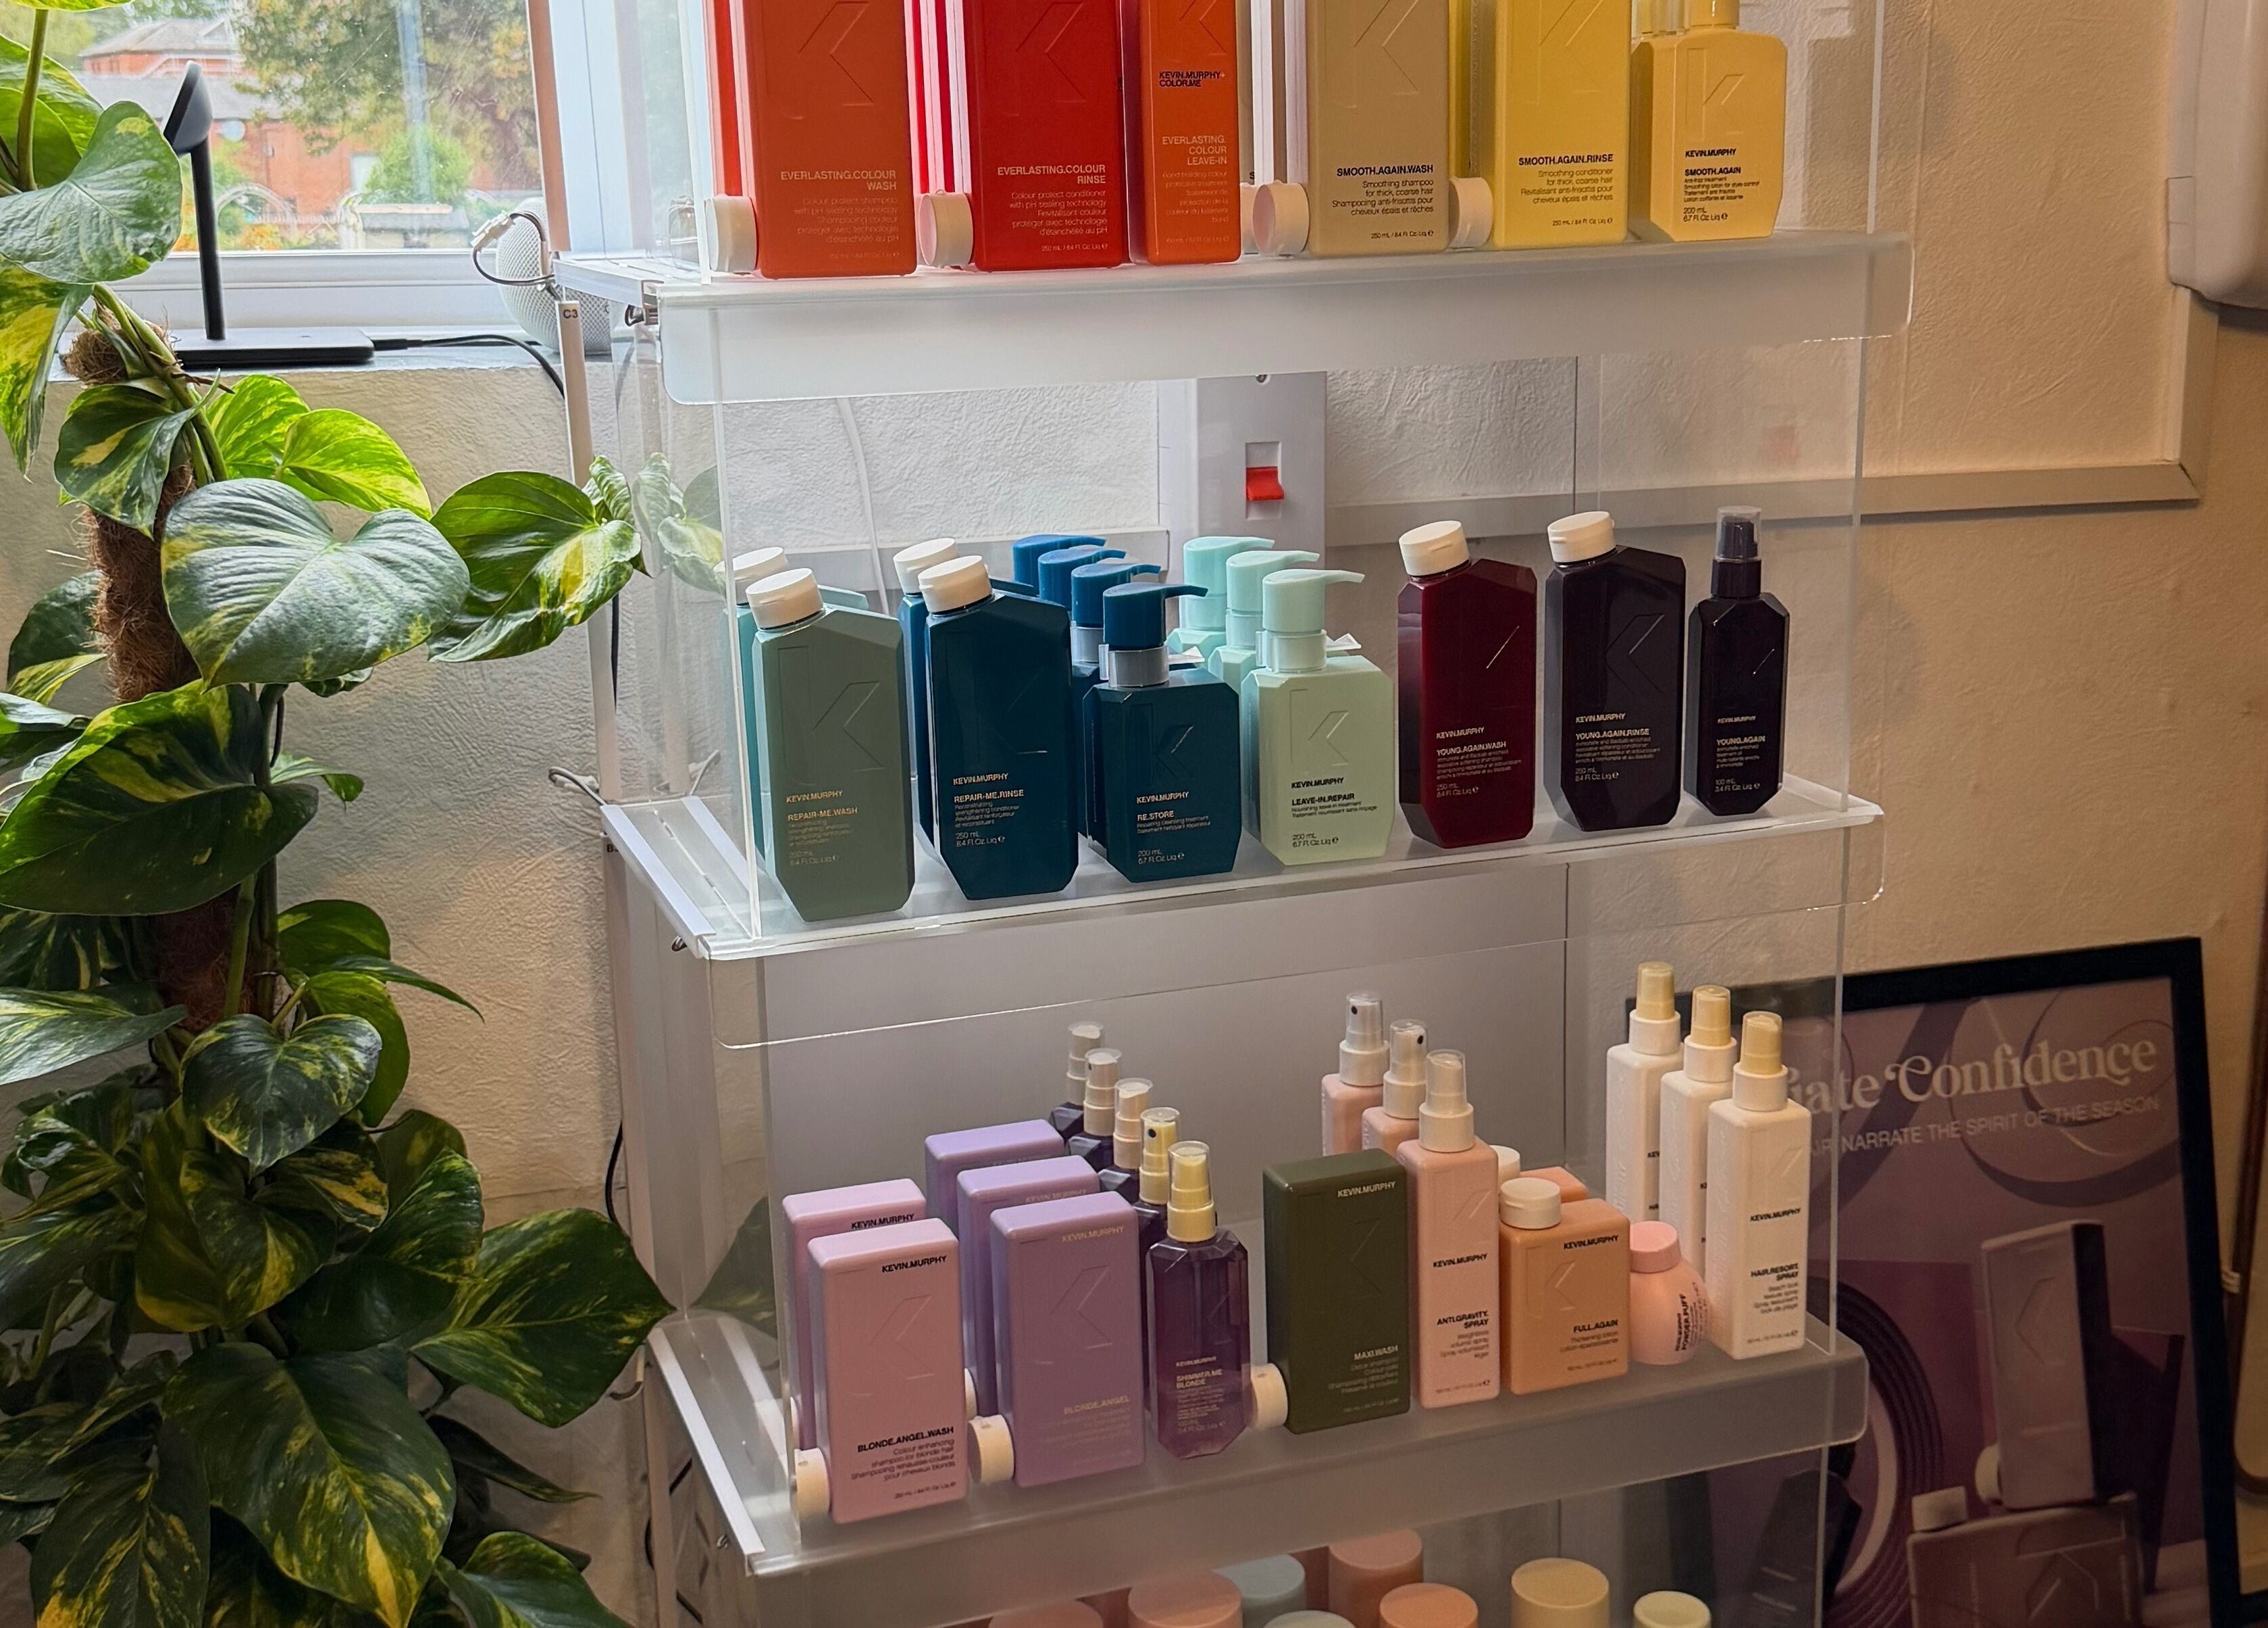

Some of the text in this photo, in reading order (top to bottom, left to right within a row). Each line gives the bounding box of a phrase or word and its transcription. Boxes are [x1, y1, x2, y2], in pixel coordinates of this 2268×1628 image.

[1159, 79, 1202, 87] COLOR.ME
[1189, 146, 1227, 155] COLOUR
[1685, 149, 1736, 157] KEVIN.MURPHY
[1187, 156, 1227, 166] LEAVE-IN
[1519, 154, 1614, 166] SMOOTH.AGAIN.RINSE
[781, 170, 896, 180] EVERLASTING.COLOUR
[998, 165, 1106, 176] EVERLASTING.COLOUR
[1337, 165, 1433, 176] SMOOTH.AGAIN.WASH
[1685, 167, 1741, 176] SMOOTH.AGAIN
[1077, 176, 1106, 184] RINSE
[867, 182, 897, 190] WASH
[1038, 191, 1064, 199] protect
[1333, 199, 1376, 207] Shampooing
[563, 309, 578, 319] C3
[1576, 713, 1626, 723] KEVIN.MURPHY
[1437, 727, 1484, 739] KEVIN.MURPHY
[1576, 729, 1649, 740] YOUNG.AGAIN.RINSE
[1717, 736, 1766, 745] YOUNG.AGAIN
[1437, 741, 1506, 756] YOUNG.AGAIN.WASH
[953, 773, 1008, 785] KEVIN.MURPHY
[1291, 778, 1343, 788] KEVIN.MURPHY
[786, 790, 843, 803] KEVIN.MURPHY
[954, 790, 1024, 803] REPAIR-ME.RINSE
[1137, 792, 1189, 803] KEVIN.MURPHY
[1292, 793, 1354, 806] LEAVE-IN.REPAIR
[788, 807, 858, 821] REPAIR-ME.WASH
[1137, 811, 1174, 821] RE.STORE
[1884, 1040, 2157, 1102] Confidence
[1841, 1126, 1924, 1152] NARRATE
[1927, 1120, 1961, 1140] THE
[1965, 1113, 2018, 1136] SPIRIT
[2024, 1110, 2046, 1127] OF
[2054, 1104, 2088, 1123] THE
[2092, 1094, 2160, 1118] SEASON
[1337, 1181, 1395, 1197] KEVIN.MURPHY
[1751, 1208, 1801, 1221] KEVIN.MURPHY
[851, 1213, 914, 1229] KEVIN.MURPHY
[1062, 1226, 1124, 1242] KEVIN.MURPHY
[1564, 1235, 1618, 1250] KEVIN.MURPHY
[882, 1255, 947, 1273] KEVIN.MURPHY
[1433, 1253, 1487, 1267] KEVIN.MURPHY
[1776, 1271, 1799, 1281] SPRAY
[1464, 1319, 1489, 1329] SPRAY
[1574, 1319, 1618, 1333] FULL.AGAIN
[1679, 1294, 1690, 1350] POWDER.PUFF
[1354, 1345, 1398, 1360] MAXI.WASH
[1177, 1379, 1206, 1389] BLONDE
[858, 1427, 954, 1452] BLONDE.ANGEL.WASH
